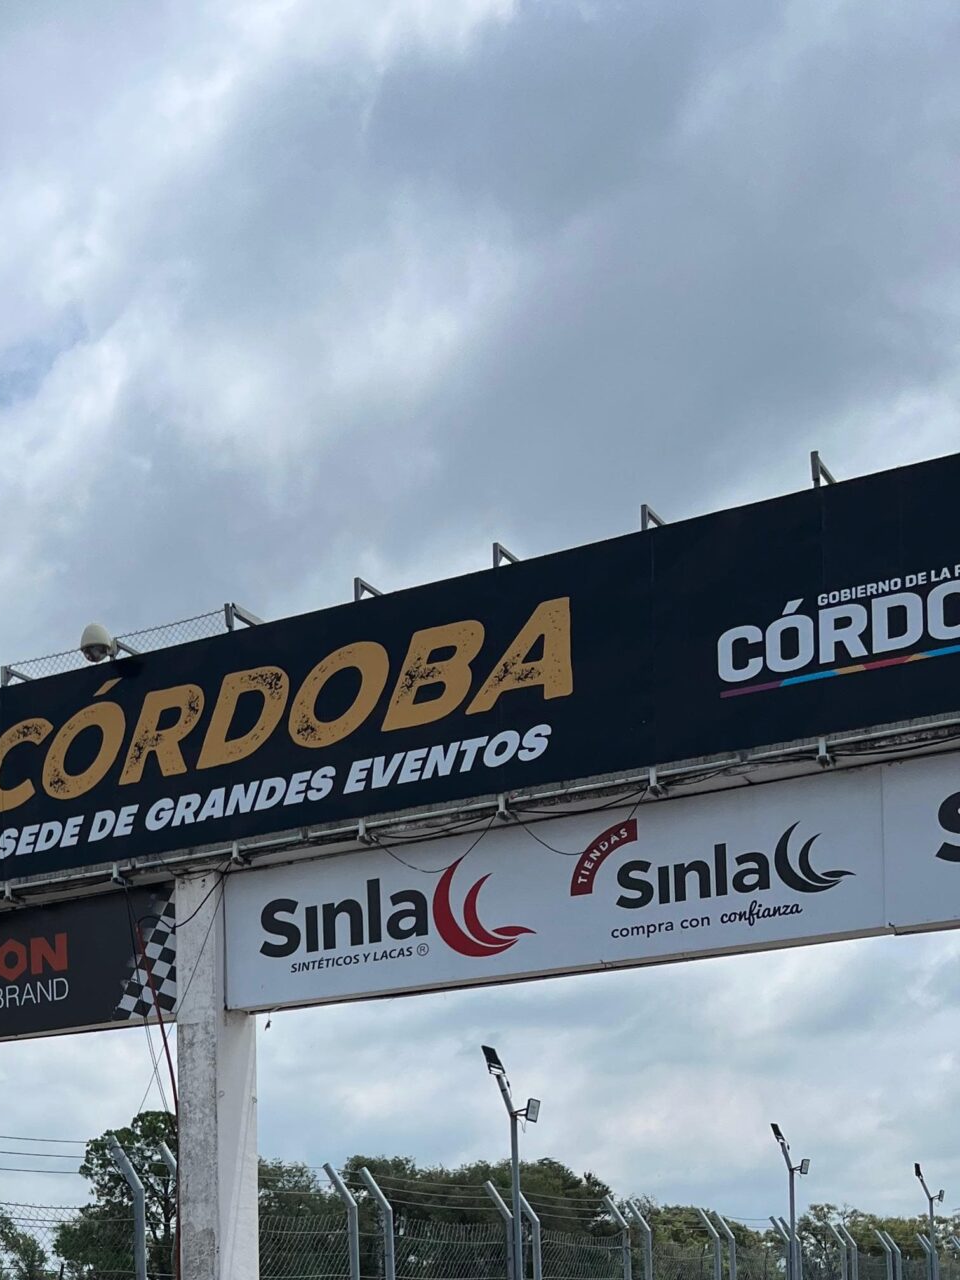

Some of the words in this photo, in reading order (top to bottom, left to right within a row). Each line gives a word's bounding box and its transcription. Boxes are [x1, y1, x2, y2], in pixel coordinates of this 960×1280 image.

[817, 578, 901, 606] GOBIERNO
[905, 571, 927, 588] DE
[930, 567, 951, 582] LA
[87, 804, 139, 843] DE
[140, 766, 336, 832] GRANDES
[343, 724, 553, 795] EVENTOS
[577, 828, 628, 884] TIENDAS
[611, 920, 675, 939] compra
[680, 915, 711, 930] con
[720, 900, 803, 926] confianza
[290, 953, 360, 973] SINTÉTICOS
[363, 951, 371, 963] Y
[372, 946, 413, 962] LACAS
